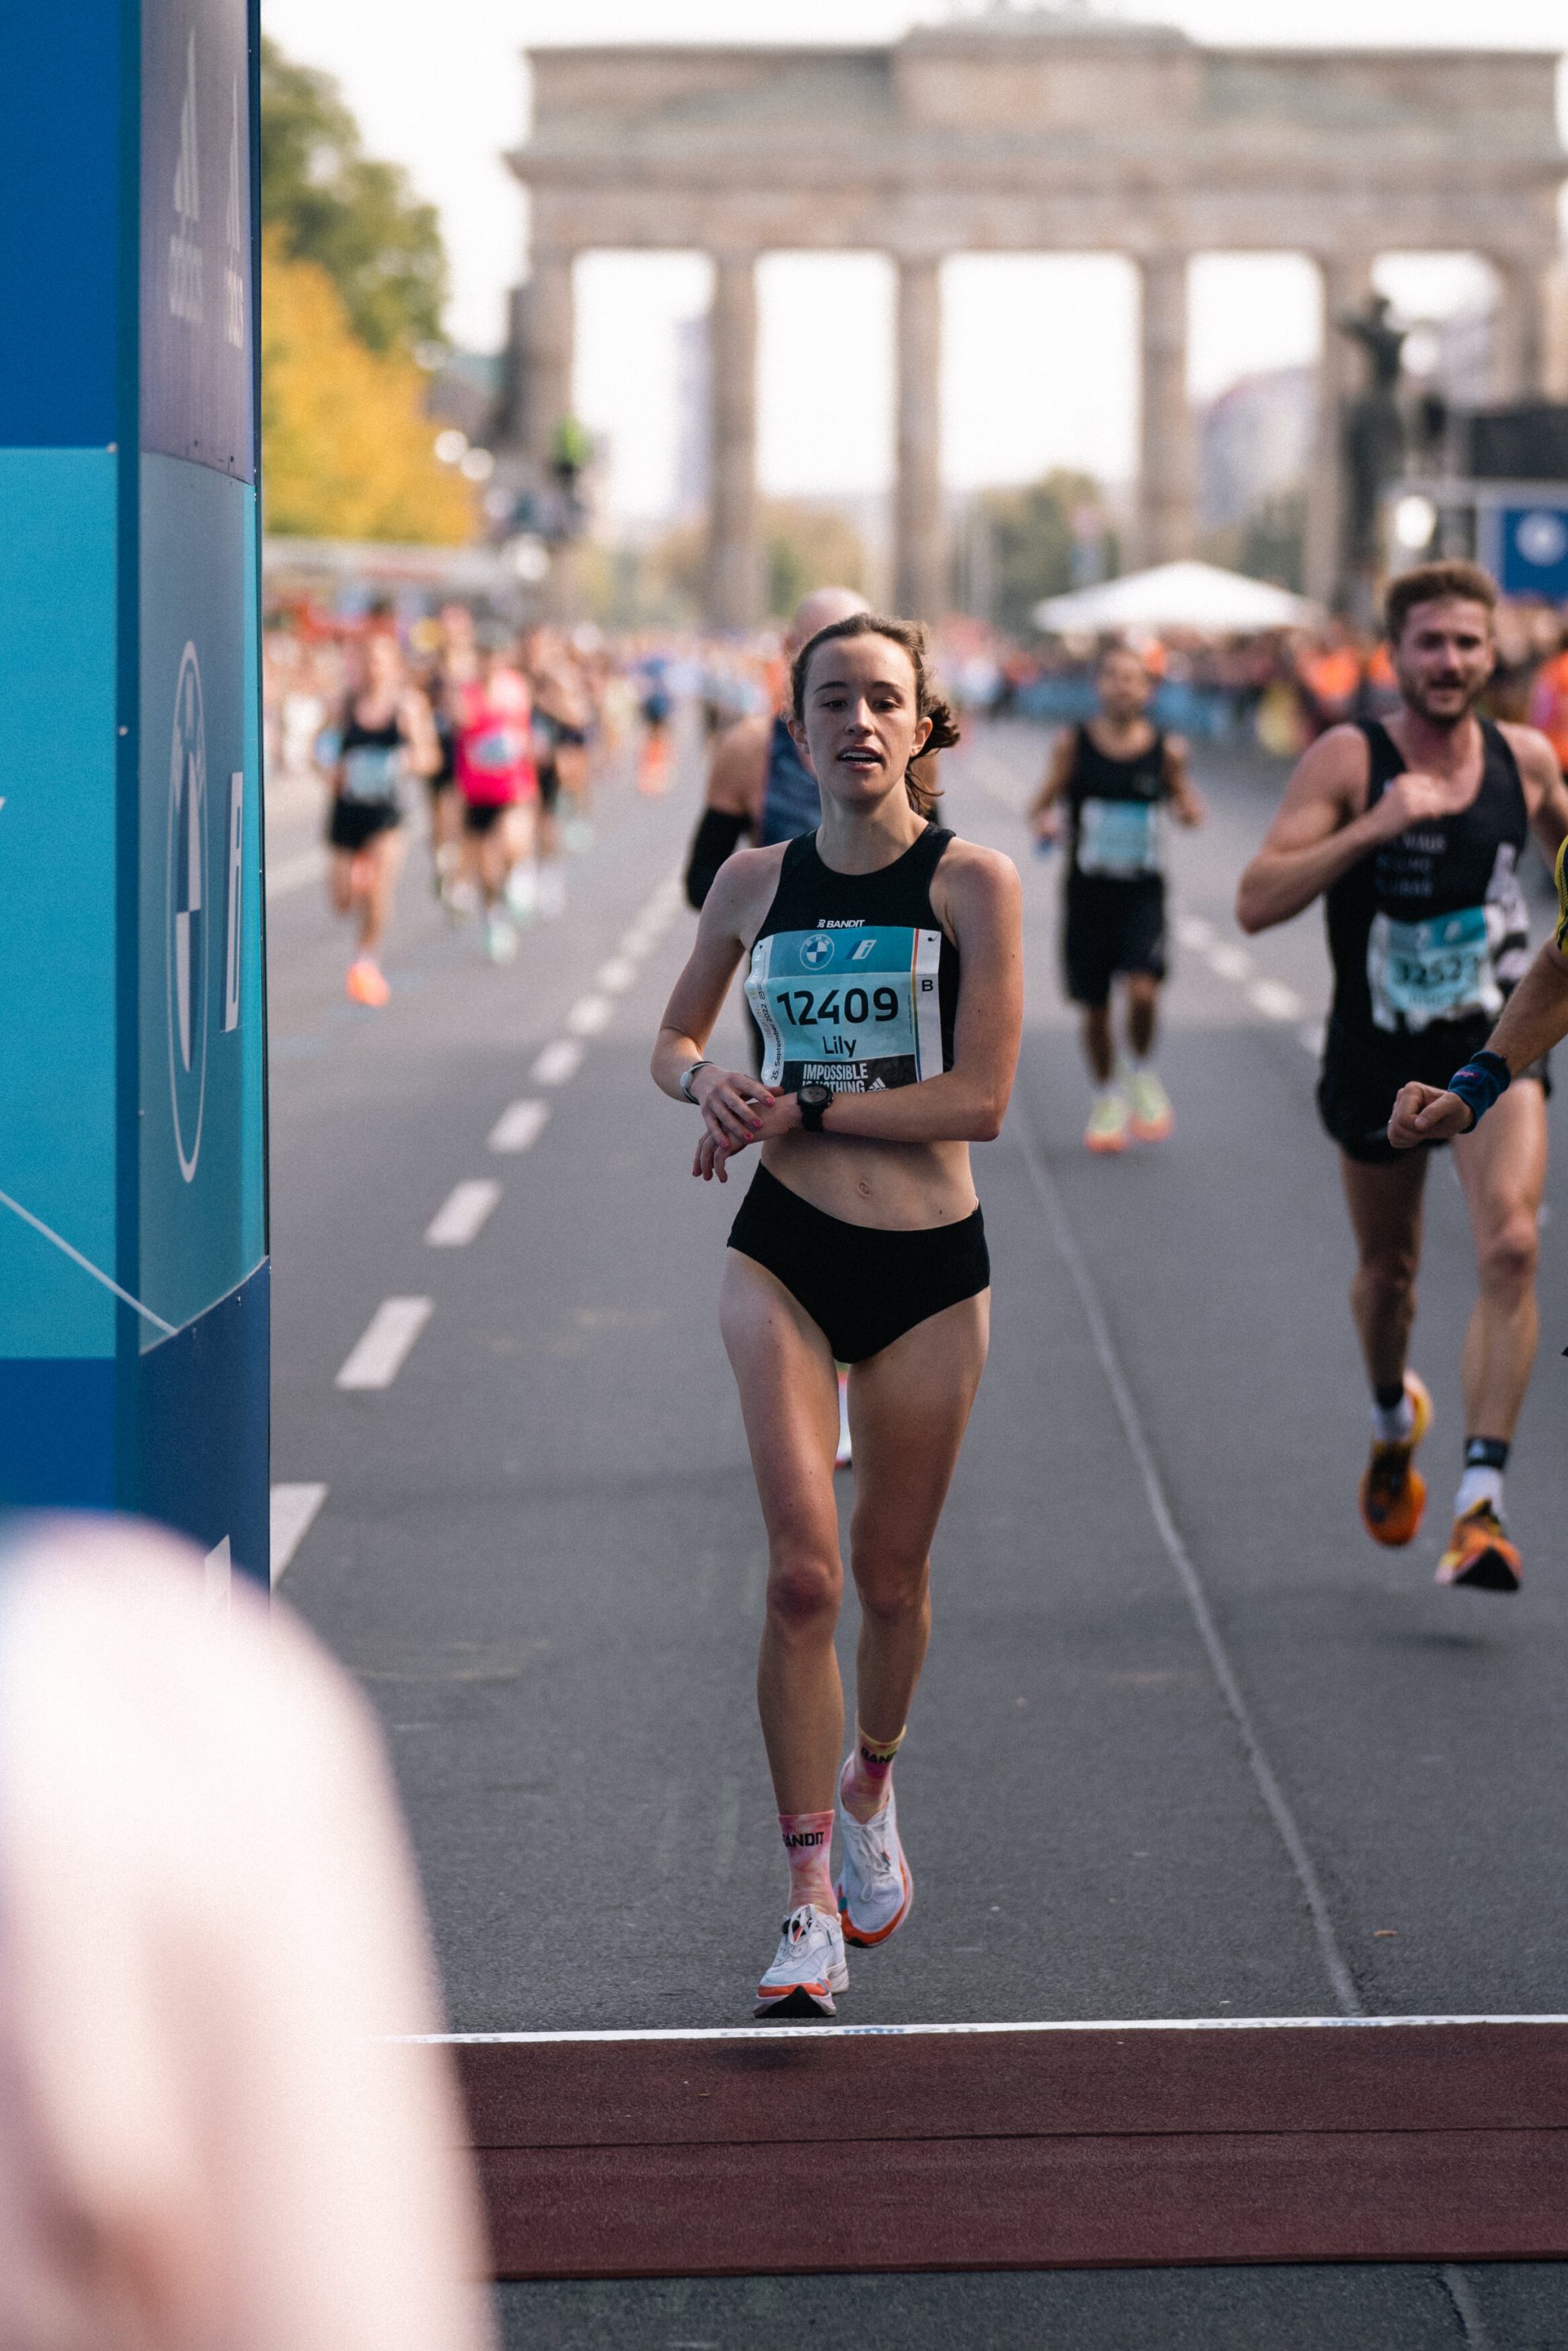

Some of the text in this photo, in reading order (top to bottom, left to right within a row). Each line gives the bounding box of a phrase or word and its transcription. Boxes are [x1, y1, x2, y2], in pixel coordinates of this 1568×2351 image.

[826, 919, 866, 929] BANDIT
[921, 979, 934, 992] B
[760, 1003, 772, 1023] 2022
[777, 987, 899, 1026] 12409
[769, 1022, 781, 1067] September
[823, 1036, 857, 1058] Lily
[771, 1067, 780, 1080] 25.
[803, 1063, 869, 1081] IMPOSSIBLE
